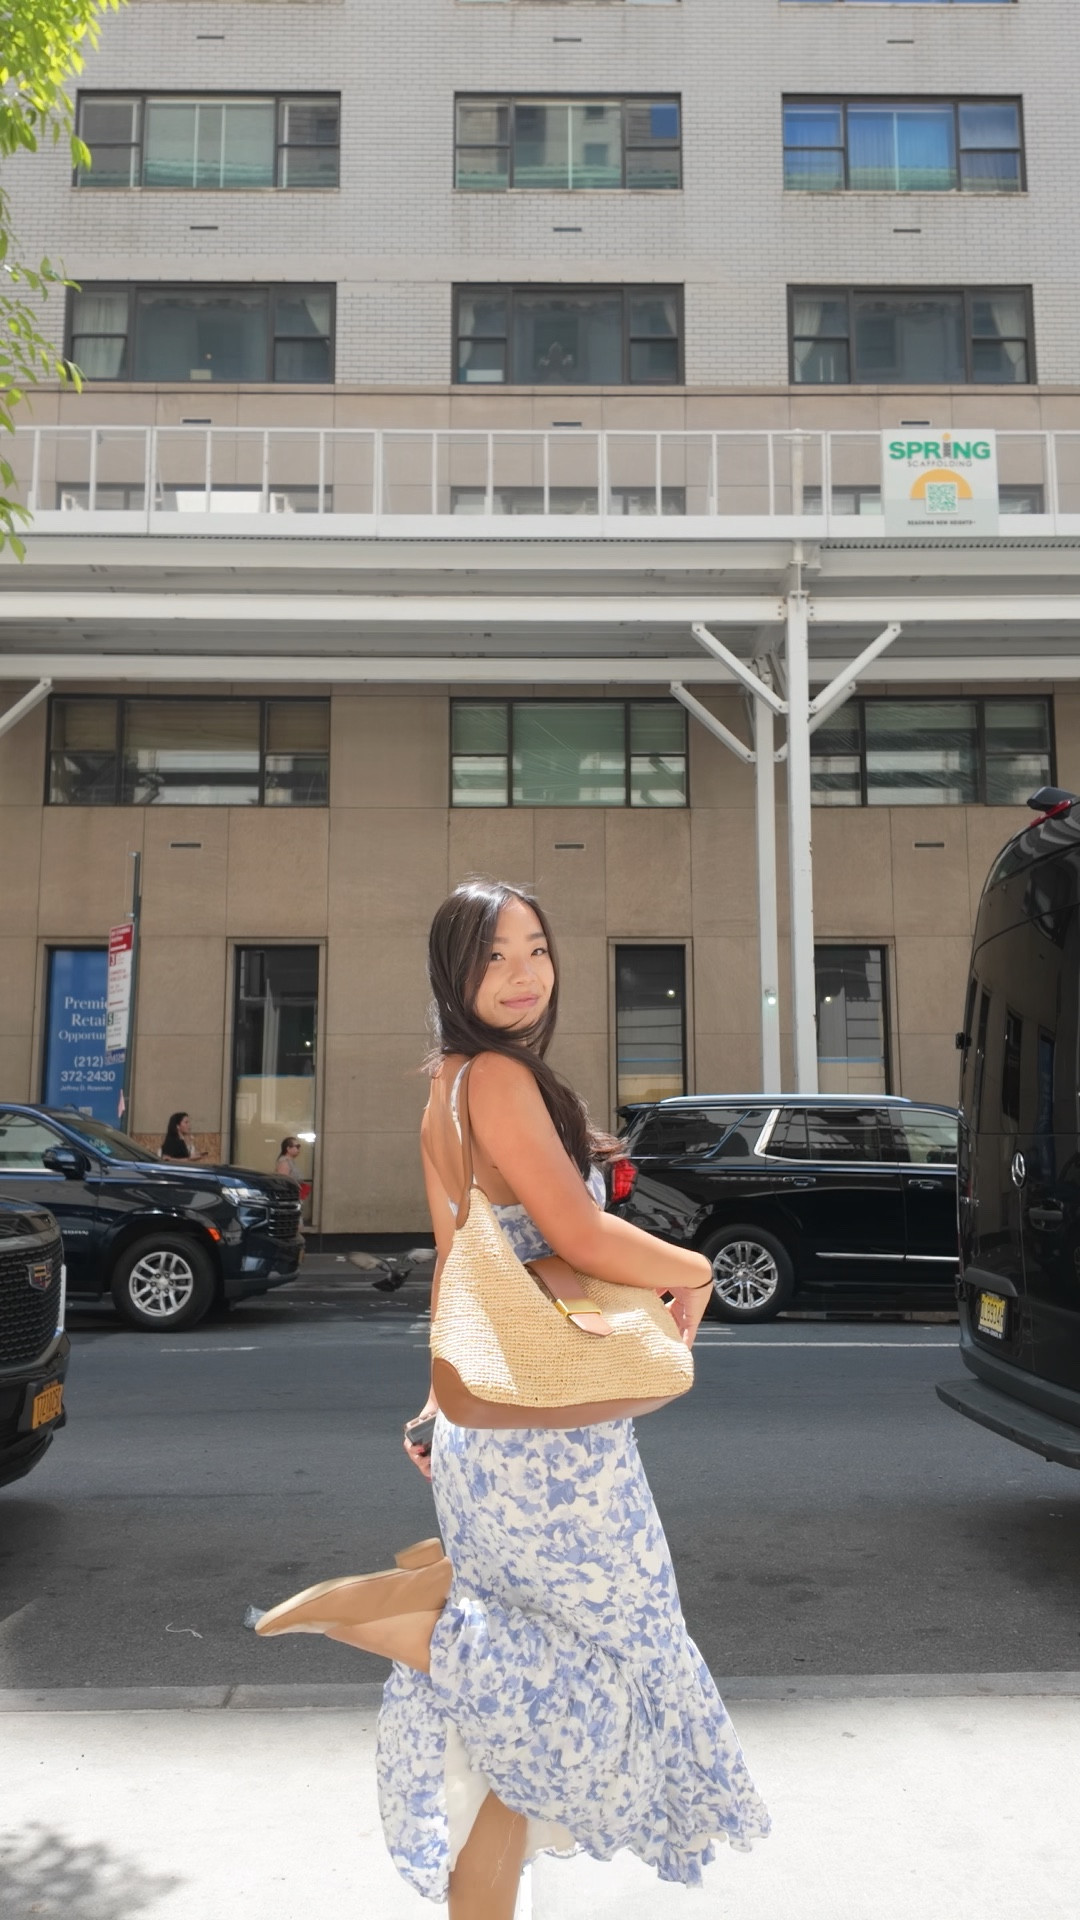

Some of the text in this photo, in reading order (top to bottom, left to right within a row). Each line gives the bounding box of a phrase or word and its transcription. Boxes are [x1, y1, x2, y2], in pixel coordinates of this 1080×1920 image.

[71, 1013, 106, 1027] Retai
[74, 1056, 103, 1068] (212)
[60, 1070, 116, 1082] 372-2430
